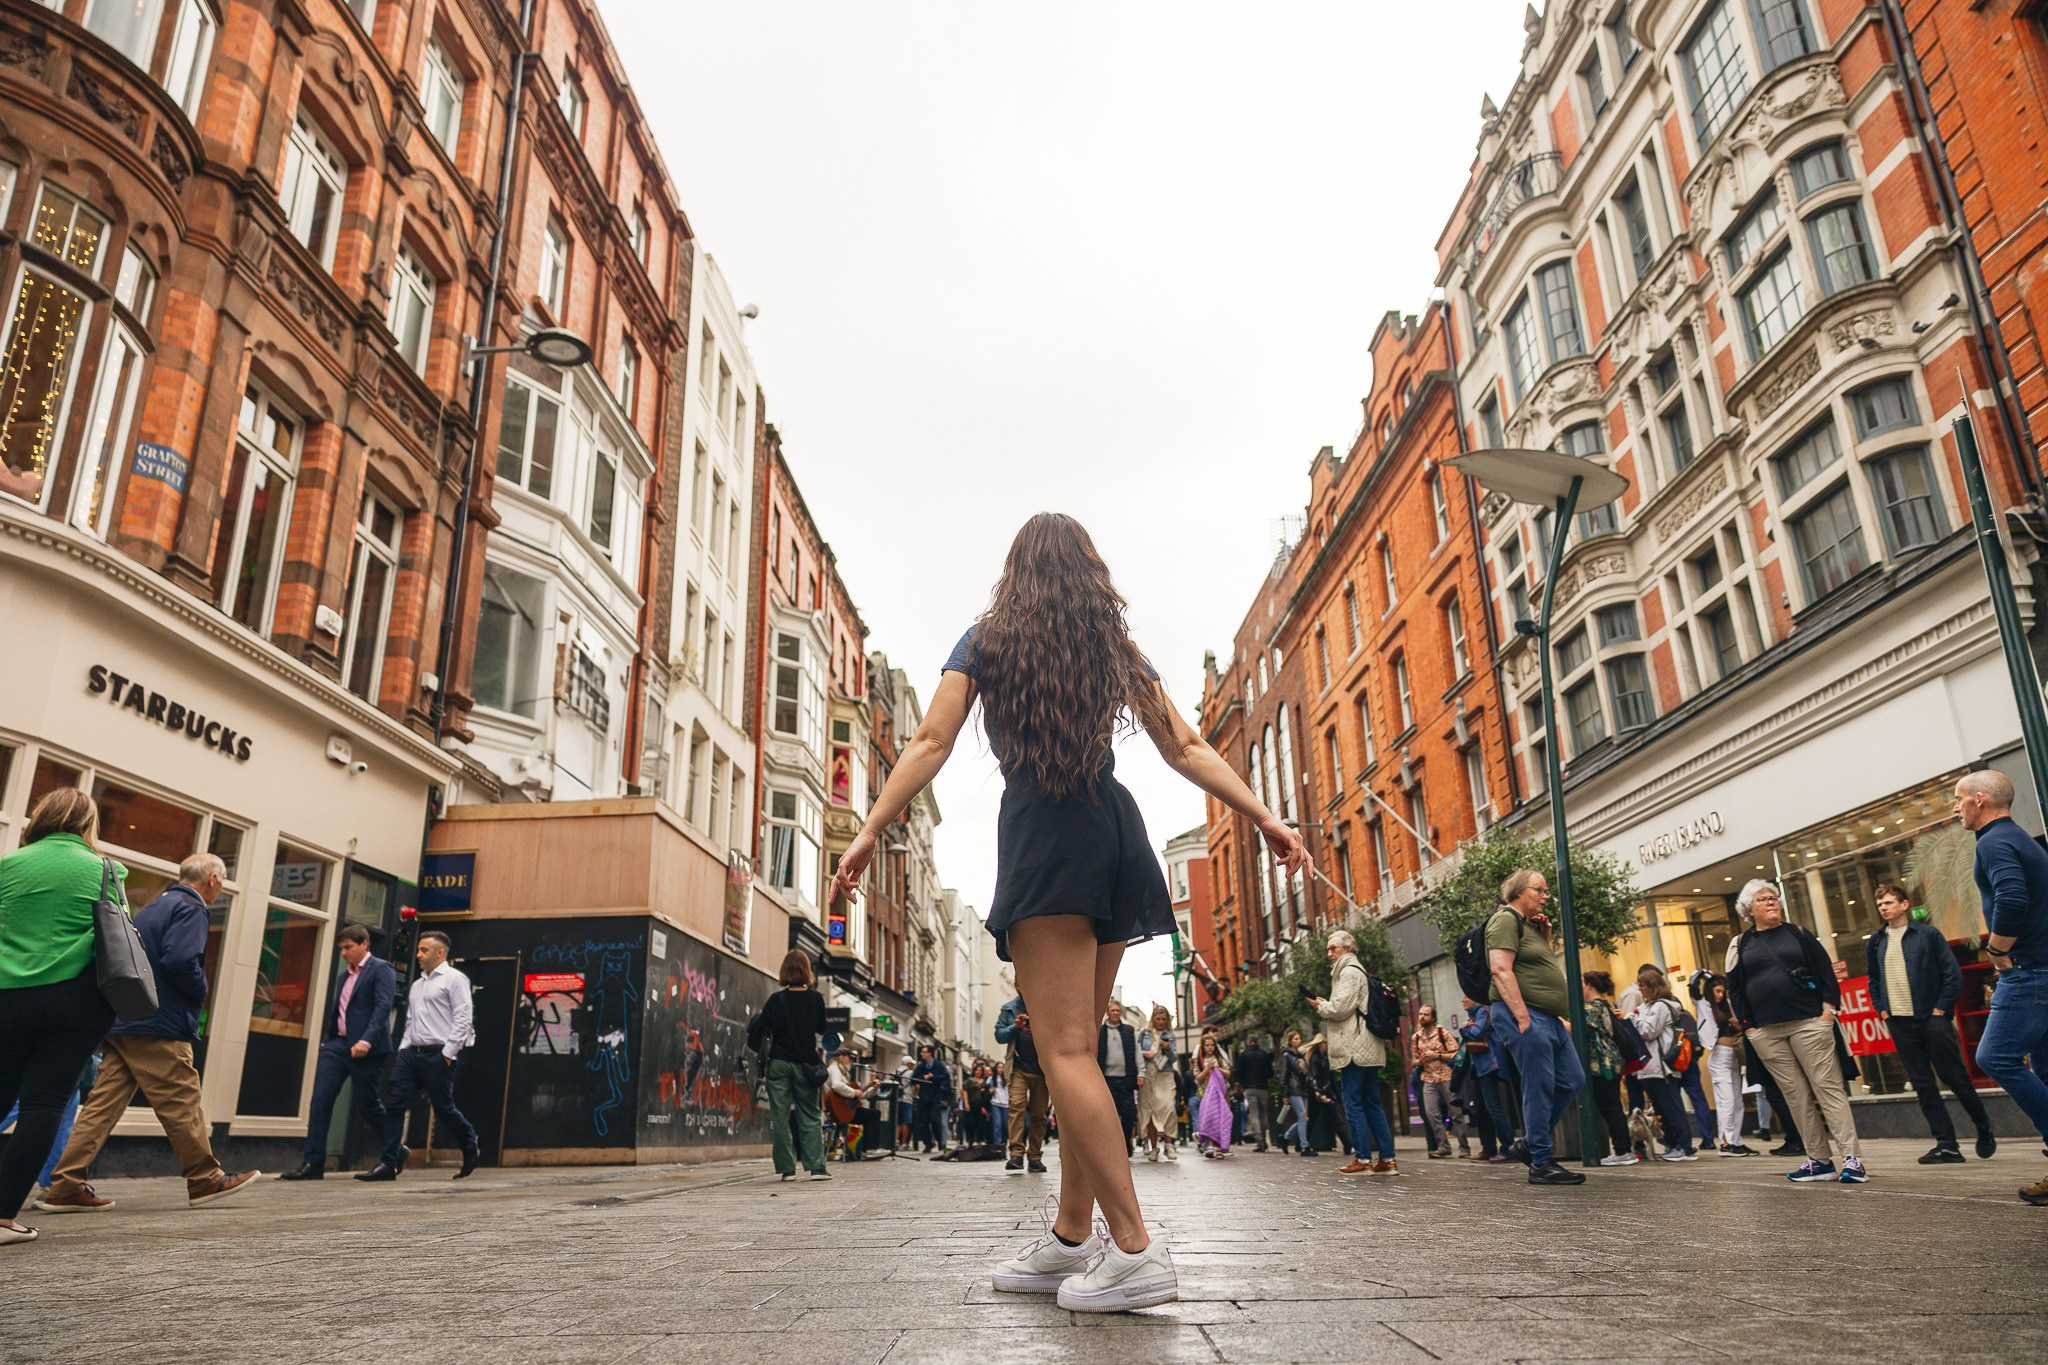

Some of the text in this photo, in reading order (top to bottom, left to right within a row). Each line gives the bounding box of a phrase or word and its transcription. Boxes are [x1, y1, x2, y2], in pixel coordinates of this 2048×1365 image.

[88, 664, 253, 762] STARBUCKS
[1639, 811, 1726, 866] RIVER ISLAND
[423, 874, 468, 888] FADE
[1840, 989, 1870, 1014] ALE
